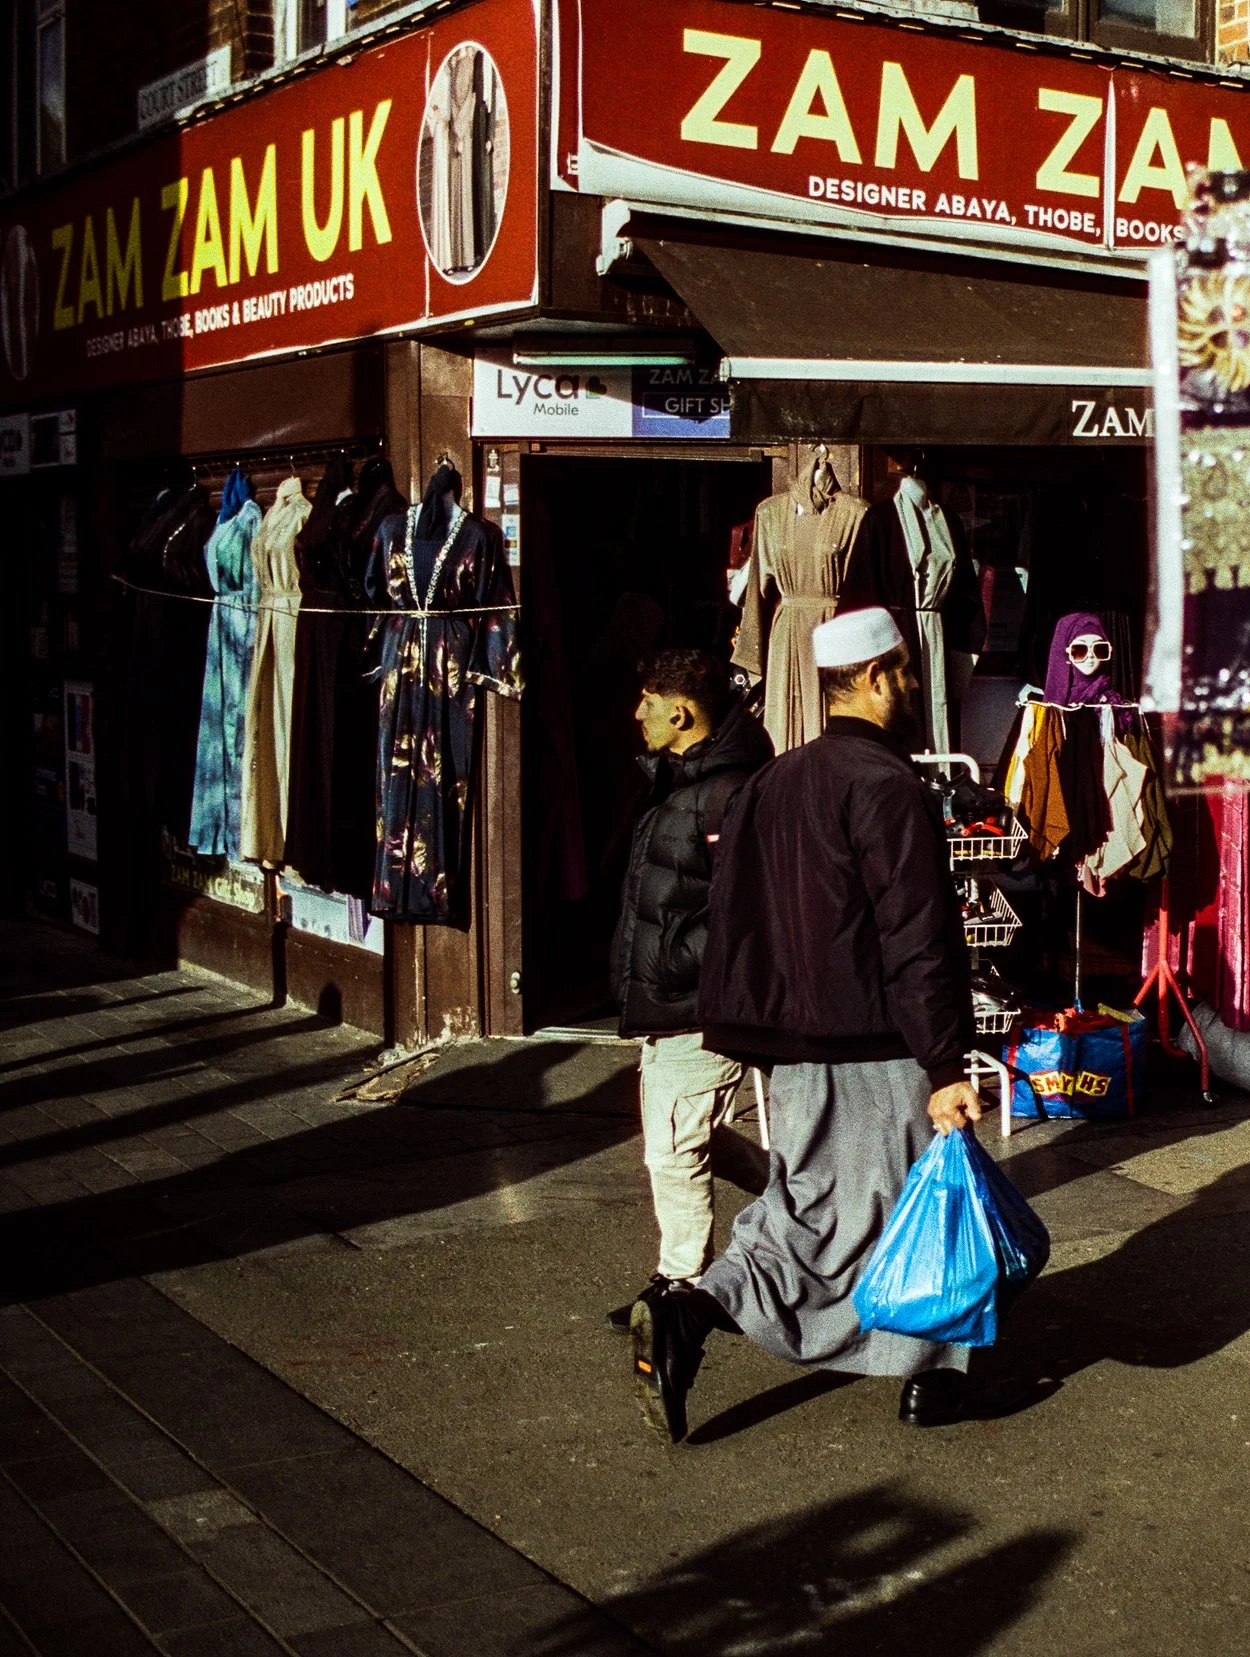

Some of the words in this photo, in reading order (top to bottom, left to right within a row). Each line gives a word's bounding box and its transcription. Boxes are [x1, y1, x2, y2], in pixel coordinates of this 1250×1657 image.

[681, 28, 979, 181] ZAM
[52, 197, 143, 331] ZAM
[162, 143, 279, 301] ZAM
[302, 99, 392, 262] UK
[808, 175, 927, 212] DESIGNER
[934, 193, 1017, 226] ABAYA,
[1024, 204, 1101, 237] THOBE,
[1116, 217, 1185, 243] BOOKS
[86, 330, 124, 357] DESIGNER
[127, 323, 159, 348] ABAYA,
[161, 312, 193, 340] THOBE,
[195, 303, 230, 334] BOOKS
[231, 301, 240, 325] &
[242, 290, 287, 323] BEAUTY
[289, 273, 355, 312] PRODUCTS
[496, 368, 580, 406] Lyca
[649, 369, 694, 385] ZAM
[533, 402, 579, 416] Mobile
[664, 397, 704, 414] GIFT
[1031, 1074, 1108, 1095] SMYHS
